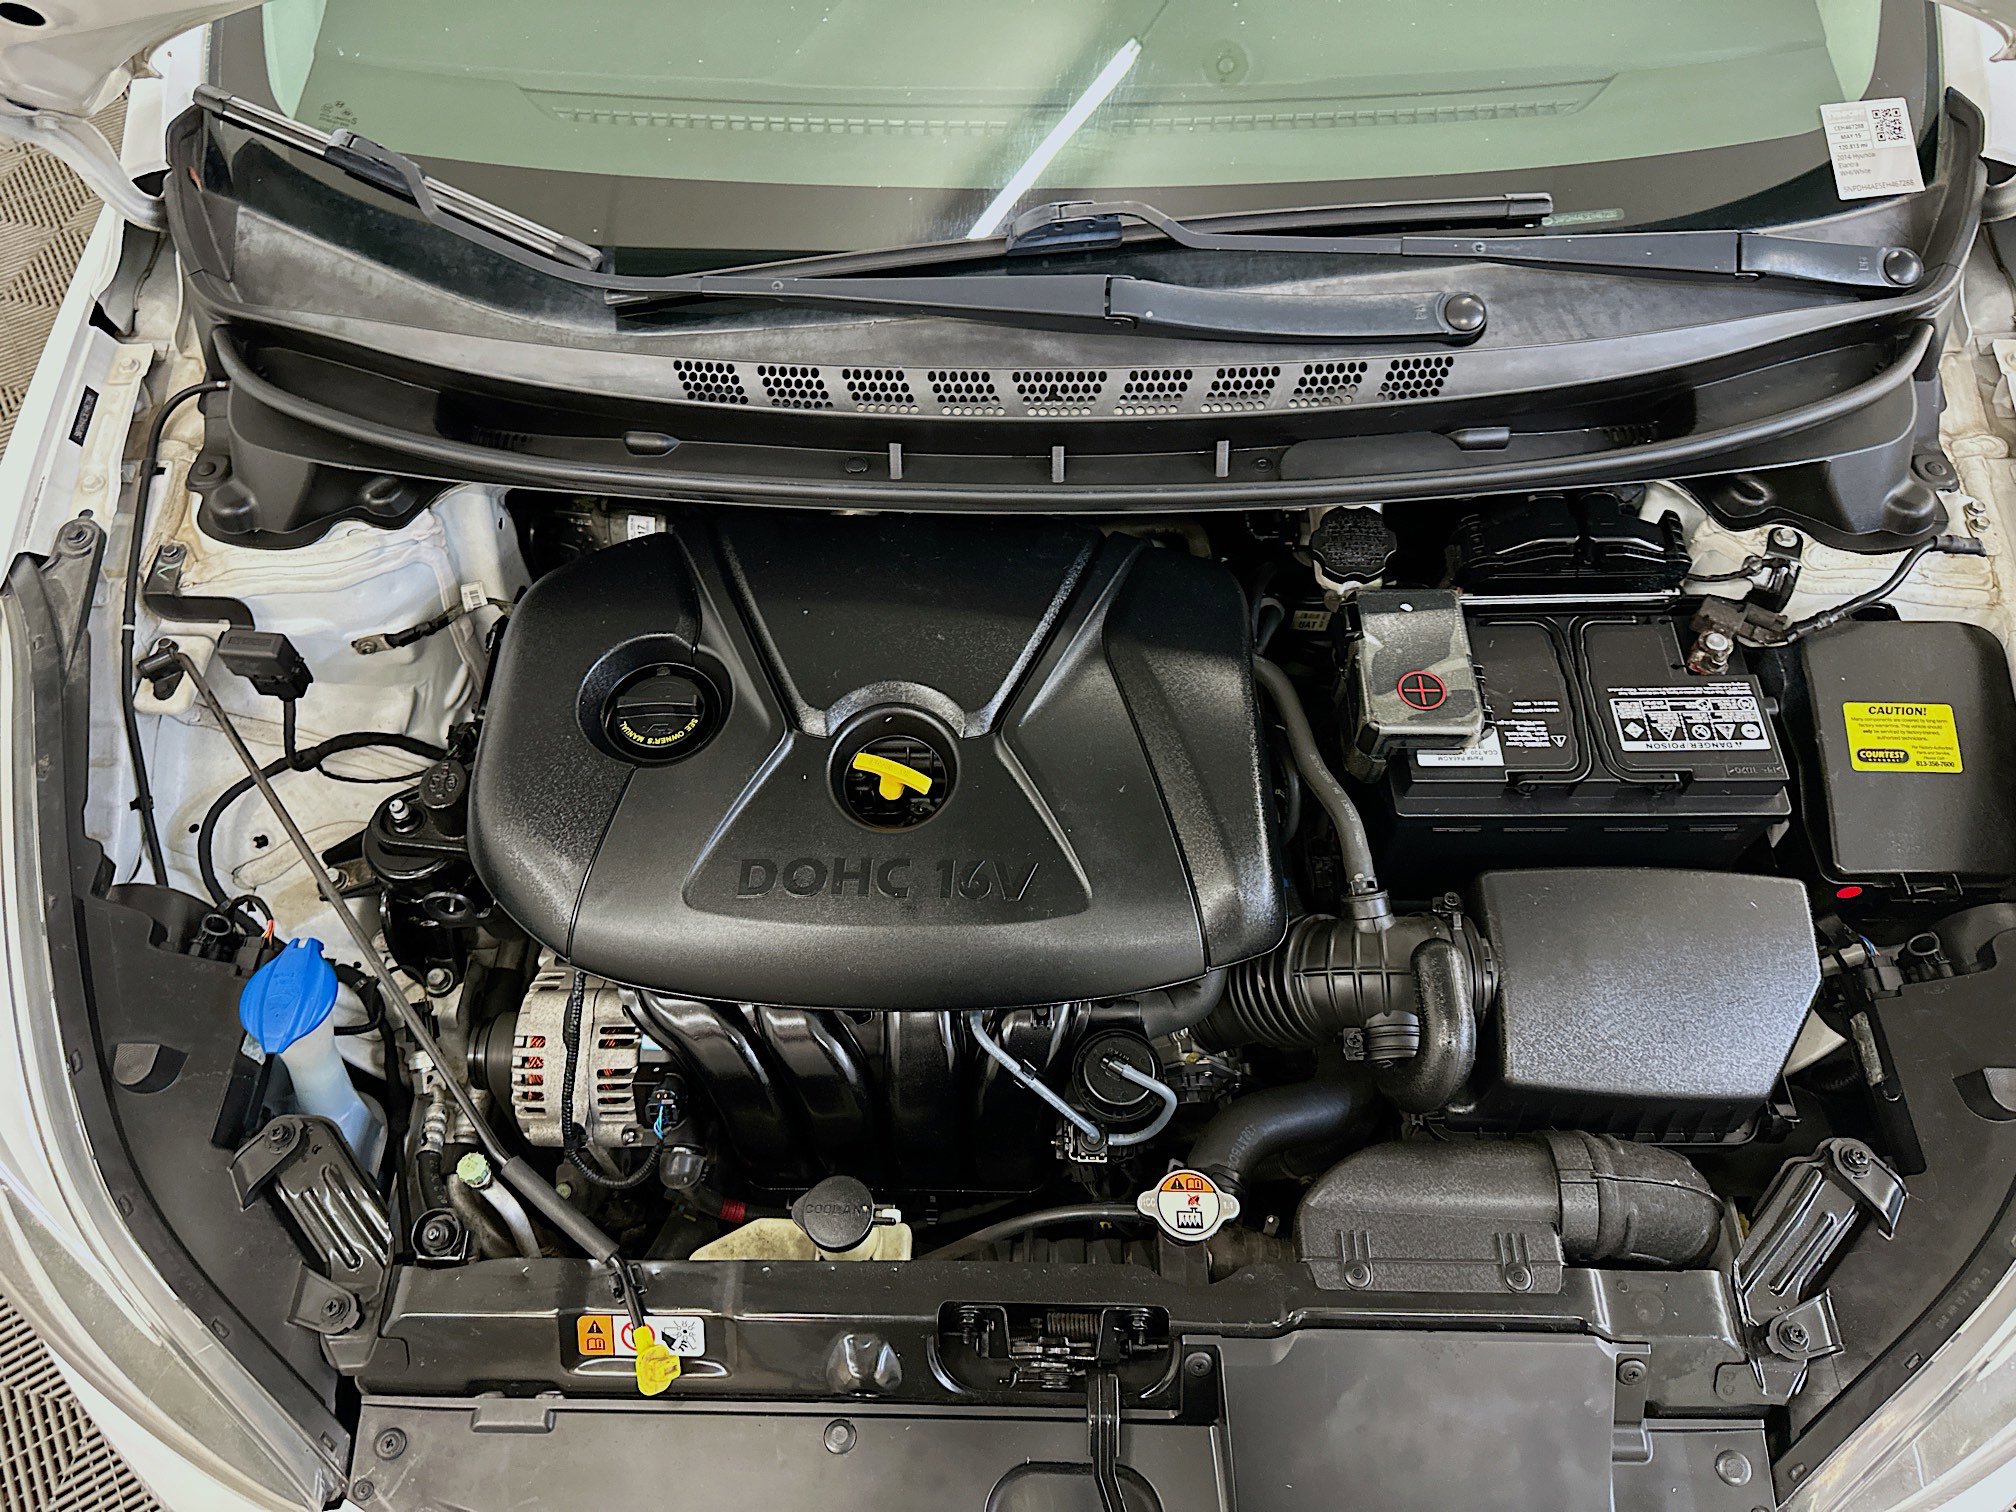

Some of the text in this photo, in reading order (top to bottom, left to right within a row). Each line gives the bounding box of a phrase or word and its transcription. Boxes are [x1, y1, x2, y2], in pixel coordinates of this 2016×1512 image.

[1868, 706, 1927, 716] CAUTION!
[620, 718, 698, 744] SEE OWNER'S MANUAL
[1860, 750, 1905, 758] COURTESY
[736, 858, 1039, 901] DOHC 16V
